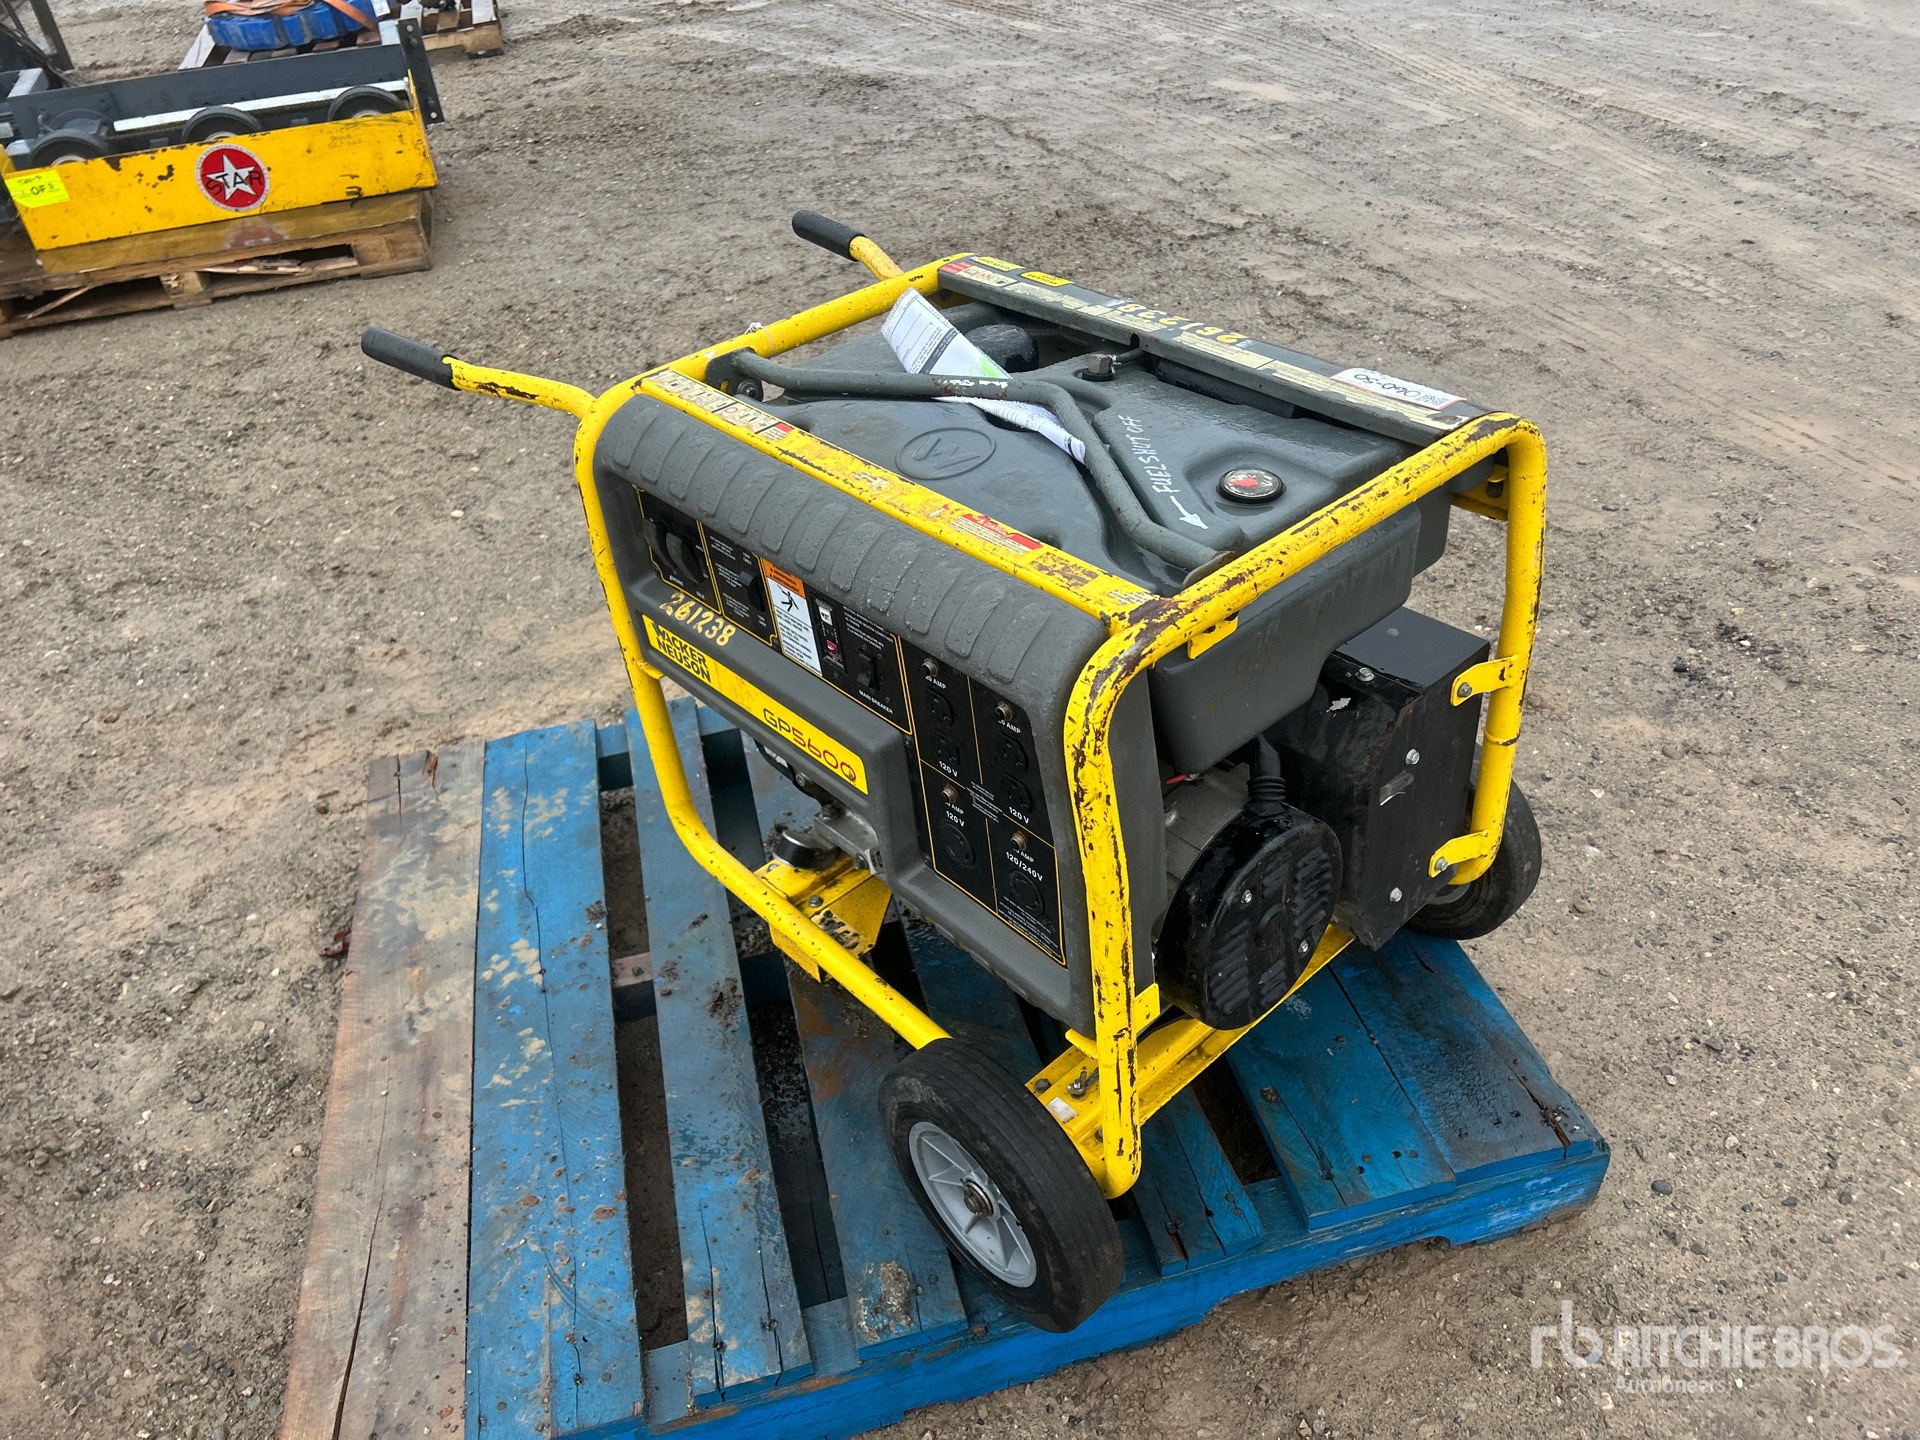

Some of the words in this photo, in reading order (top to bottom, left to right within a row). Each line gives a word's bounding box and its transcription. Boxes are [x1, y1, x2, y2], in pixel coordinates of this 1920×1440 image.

[205, 170, 263, 196] STAR
[1117, 303, 1250, 344] 261238
[659, 591, 736, 647] 261238
[653, 620, 708, 669] WACKER
[656, 637, 712, 684] NEUSON
[1006, 723, 1021, 734] AMP
[938, 761, 952, 774] 120
[945, 810, 959, 824] 120
[1008, 807, 1022, 820] 120
[1005, 852, 1043, 882] 120/240V
